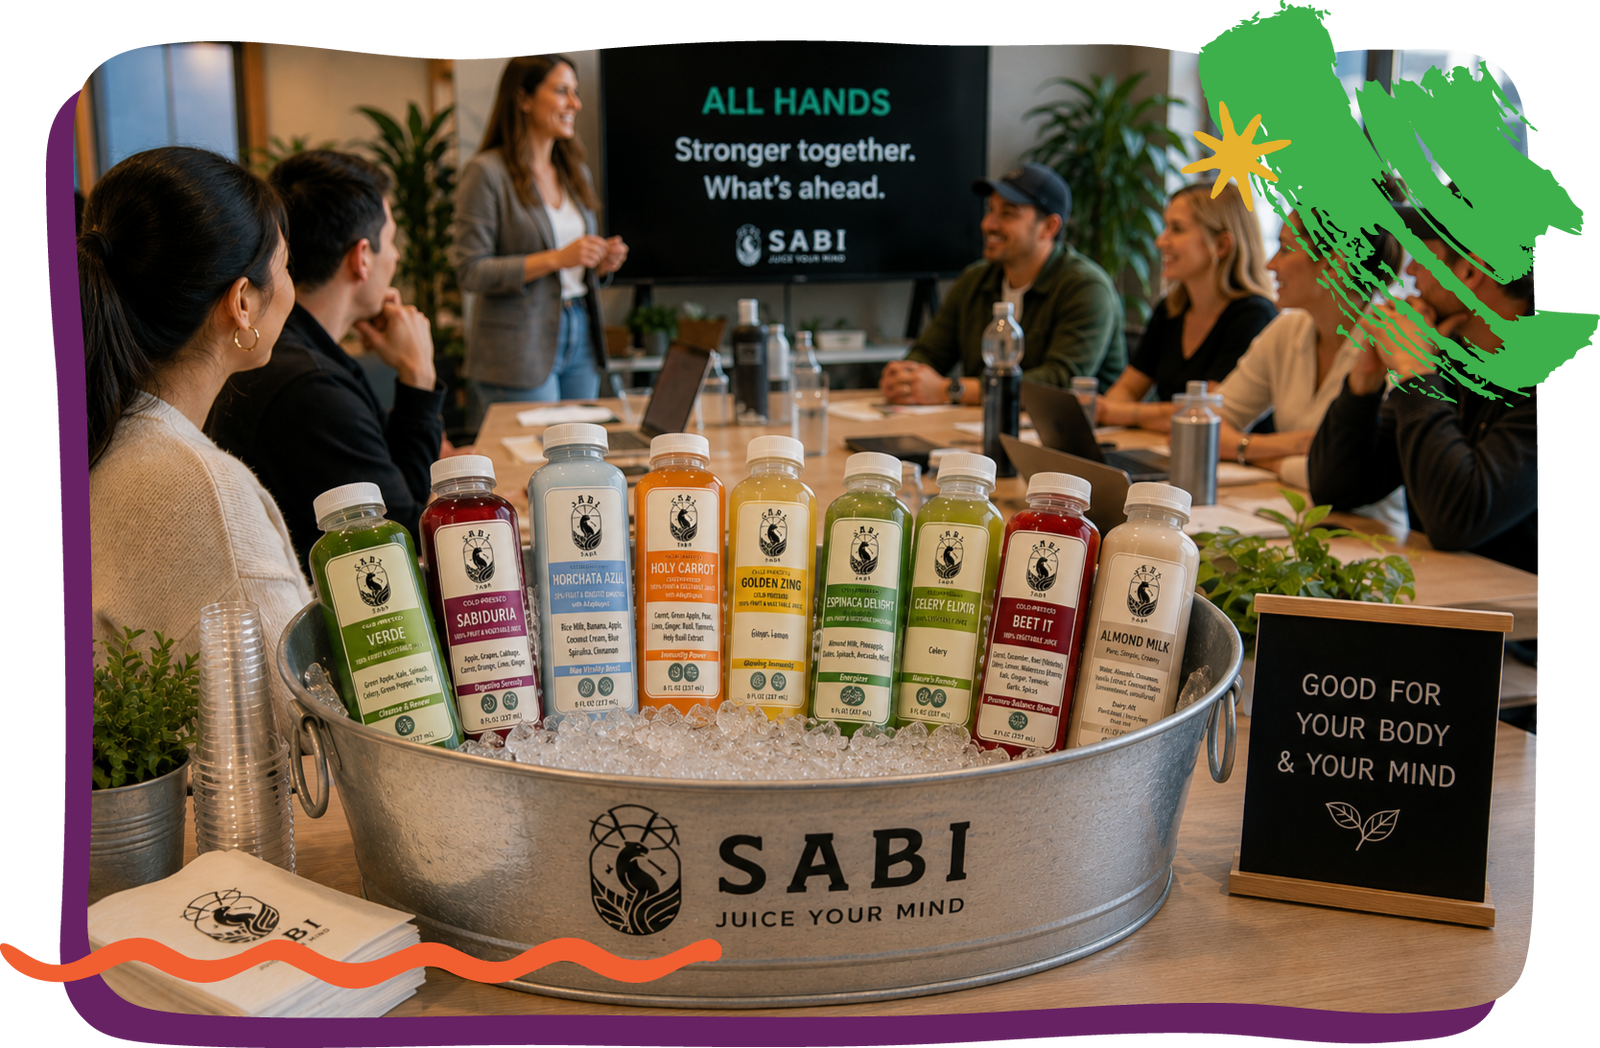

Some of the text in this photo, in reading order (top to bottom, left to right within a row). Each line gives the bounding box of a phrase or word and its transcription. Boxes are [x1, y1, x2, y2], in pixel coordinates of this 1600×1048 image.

[702, 86, 891, 116] ALL HANDS
[675, 136, 916, 168] Stronger together.
[703, 174, 886, 200] What's ahead.
[768, 229, 846, 252] SABI
[768, 254, 846, 263] JUICE YOUR MIND
[651, 561, 715, 575] HOLY CARROT
[552, 571, 625, 586] HORCHATA AZUL
[741, 577, 802, 591] GOLDEN ZING
[826, 596, 895, 611] ESPINACA DELIGHT
[915, 598, 975, 615] CELERY ELIXIR
[1016, 603, 1031, 611] COLD
[456, 607, 517, 628] SABIDURIA
[1012, 614, 1054, 633] BEET IT
[366, 626, 406, 646] VERDE
[1100, 630, 1170, 654] ALMOND MILK
[928, 645, 948, 657] Celery
[1302, 673, 1441, 706] GOOD FOR
[404, 702, 409, 711] &
[1296, 712, 1450, 747] YOUR BODY
[1277, 750, 1456, 788] & YOUR MIND
[718, 820, 971, 895] SABI
[715, 898, 965, 928] JUICE YOUR MIND
